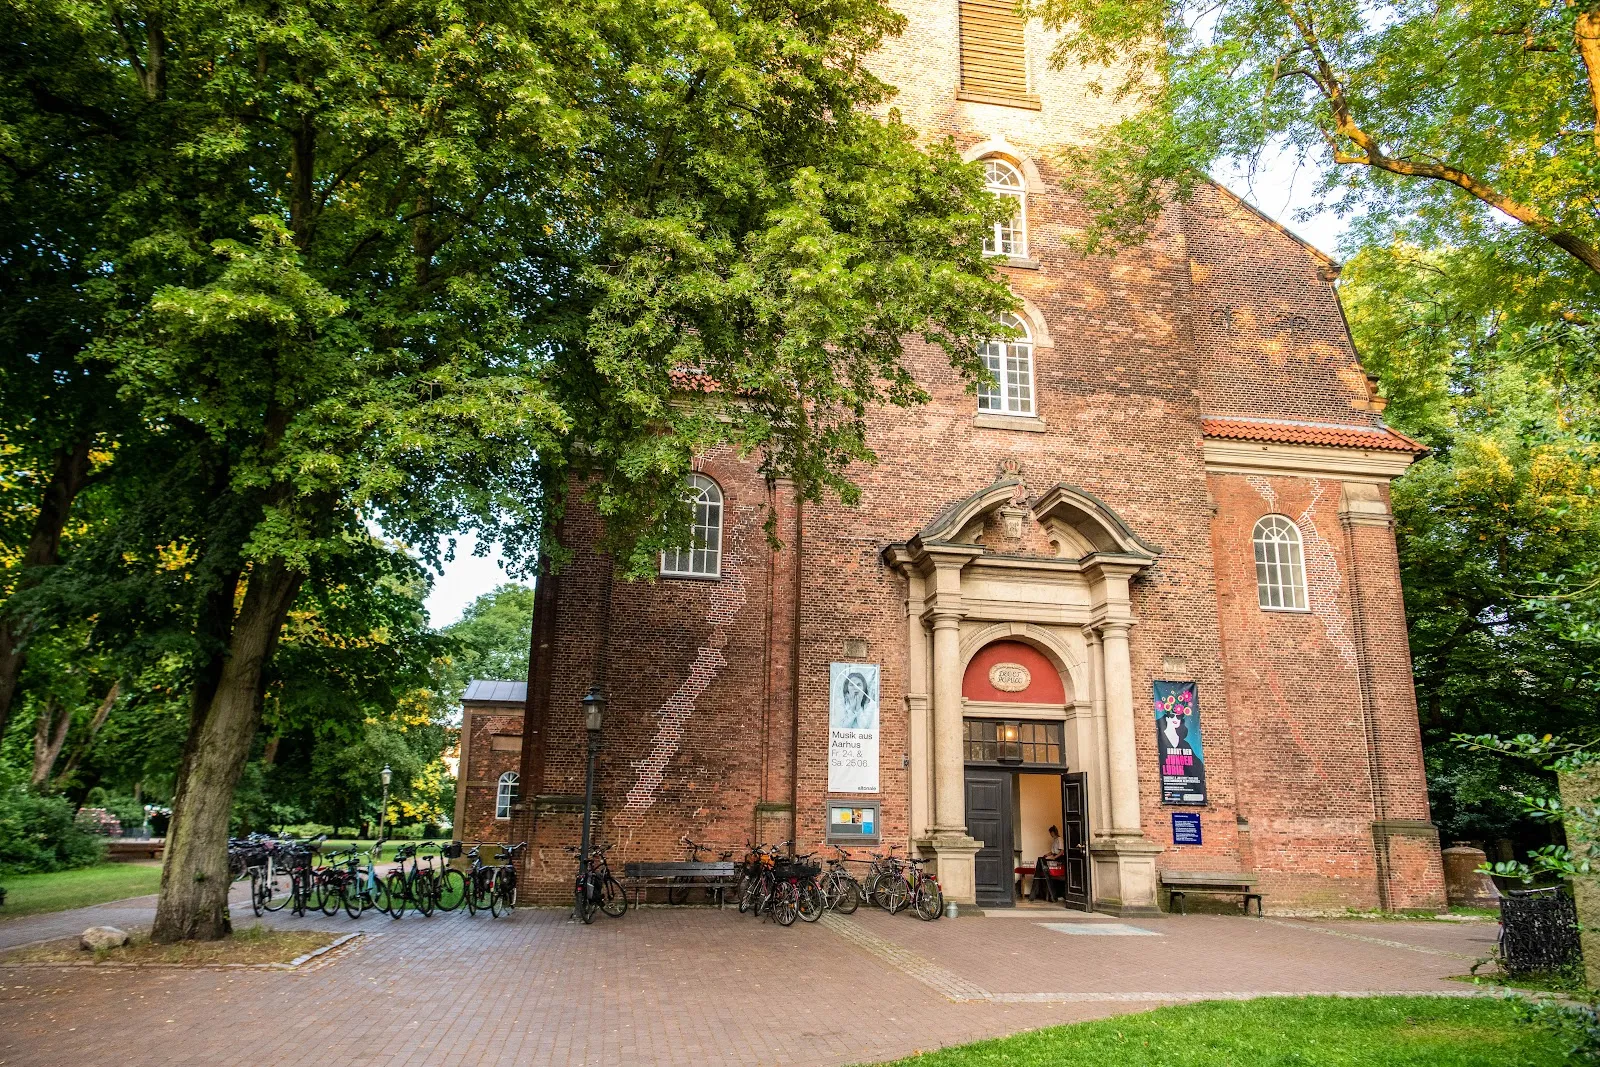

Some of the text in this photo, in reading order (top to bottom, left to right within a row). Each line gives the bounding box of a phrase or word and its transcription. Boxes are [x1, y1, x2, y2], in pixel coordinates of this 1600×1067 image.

[832, 731, 856, 739] Musik
[842, 750, 855, 758] 24.
[856, 750, 863, 758] &
[1166, 755, 1193, 766] JUNGEN
